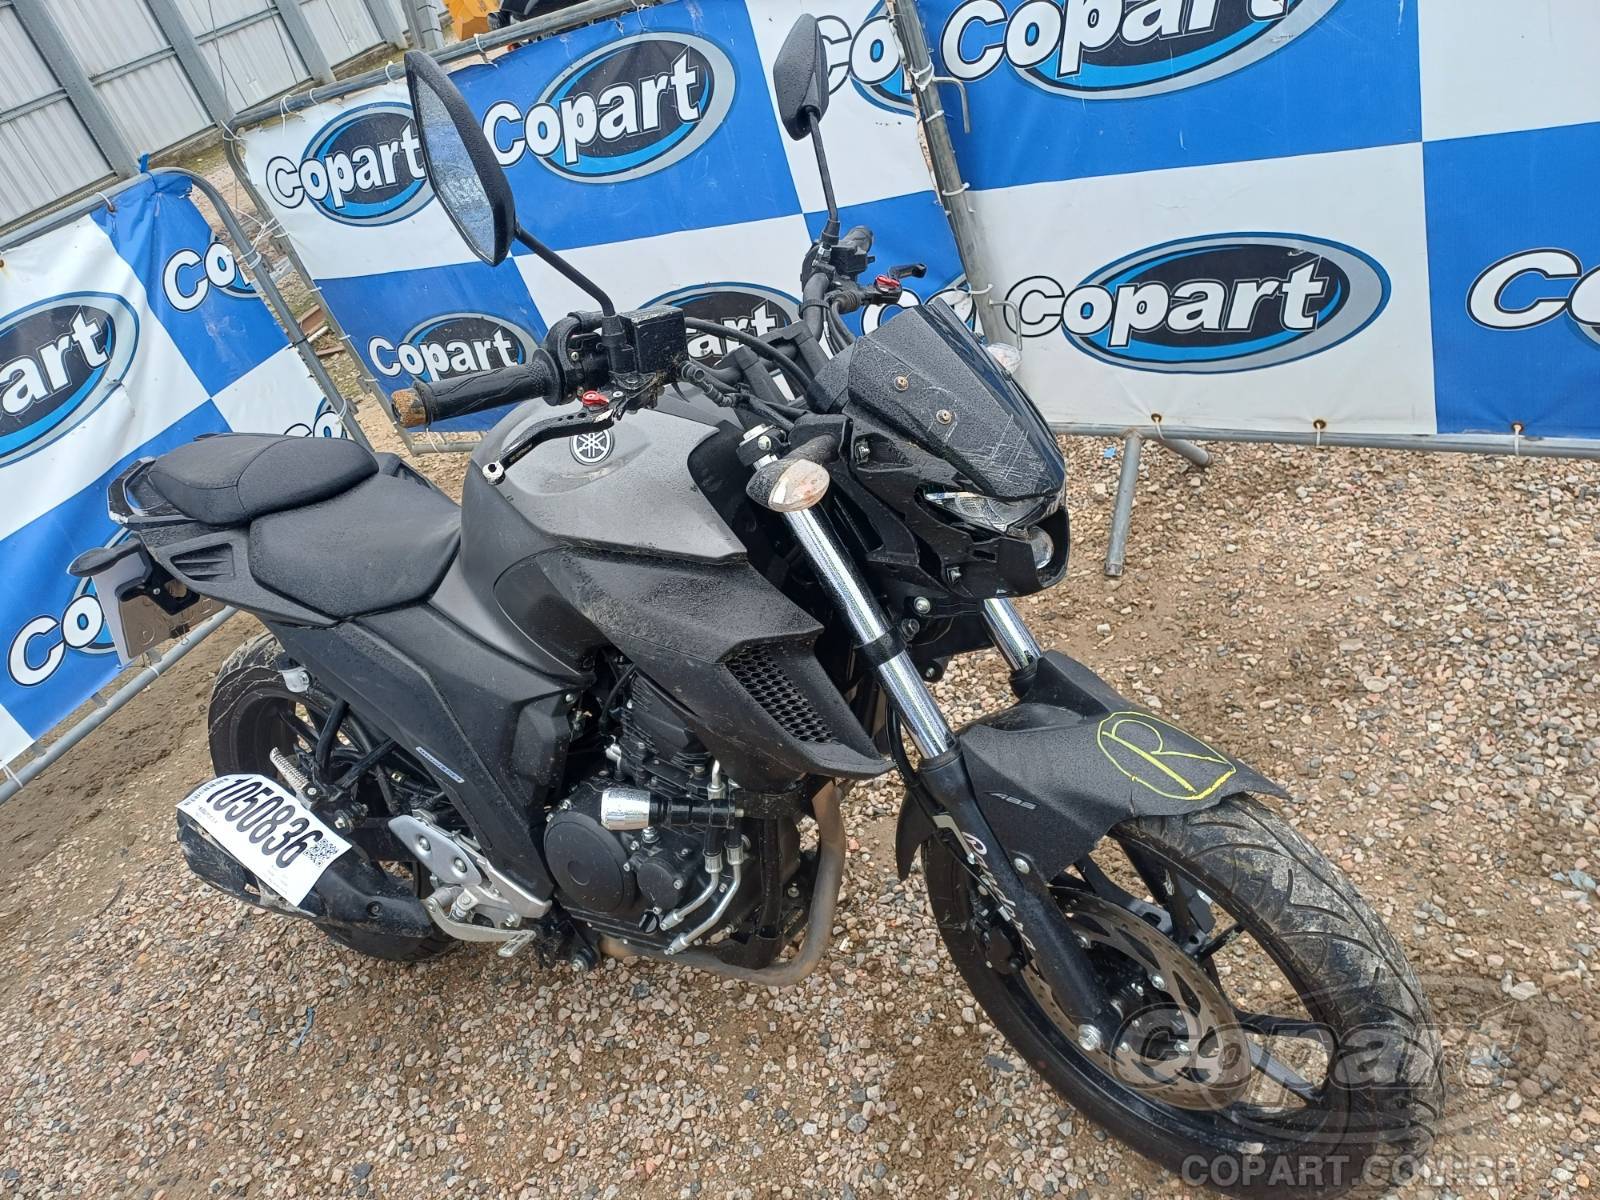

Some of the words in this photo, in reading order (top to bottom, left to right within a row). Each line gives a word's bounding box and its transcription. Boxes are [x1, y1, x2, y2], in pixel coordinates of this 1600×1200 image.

[482, 44, 703, 168] Copart
[265, 119, 428, 209] Copart
[1003, 254, 1330, 348] Copart
[367, 324, 526, 382] Copart
[206, 777, 324, 869] 1050836
